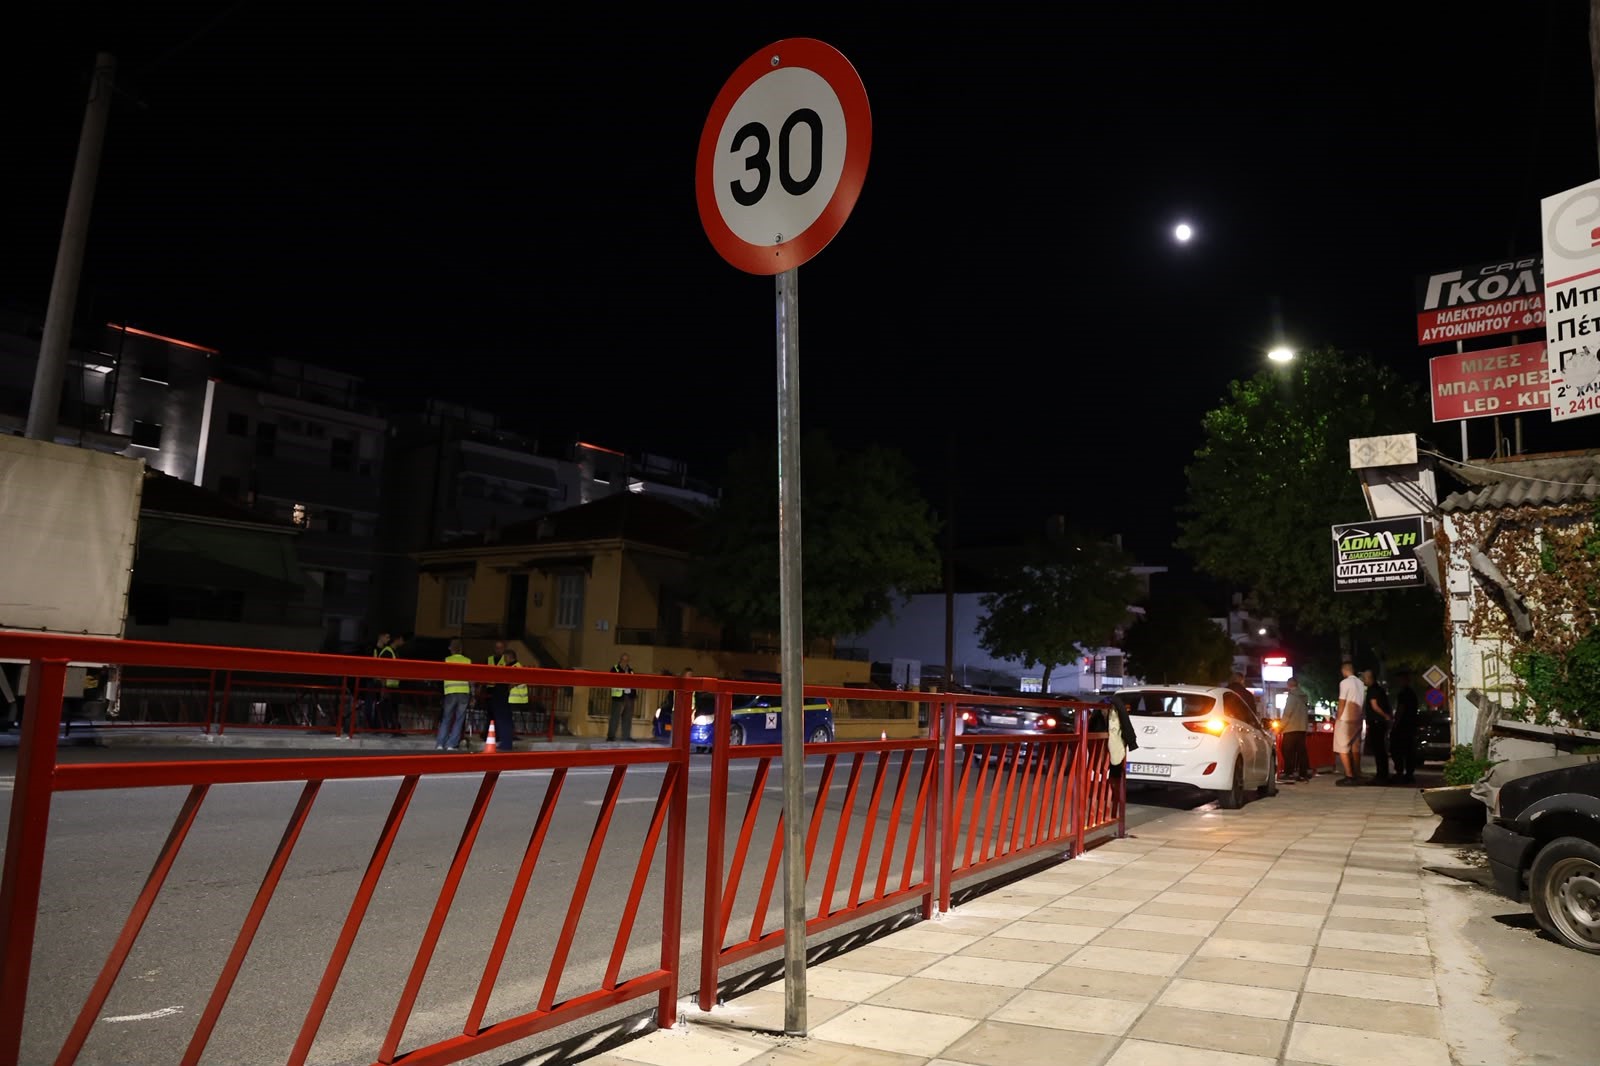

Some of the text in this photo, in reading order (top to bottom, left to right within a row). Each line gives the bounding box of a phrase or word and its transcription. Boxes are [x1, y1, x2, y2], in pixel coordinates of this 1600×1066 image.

[730, 108, 823, 206] 30
[1436, 296, 1542, 325] ΗΛΕΚΤΡΟΛΟΓΙΚΑ
[1422, 315, 1512, 341] ΑΥΤΟΚΙΝΗΤΟΥ
[1461, 353, 1522, 375] ΜΙΖΕΣ
[1437, 369, 1550, 398] ΜΠΑΤΑΡΙΕΣ
[1463, 396, 1500, 413] LED
[1339, 560, 1416, 576] ΜΠΑΤΣΙΛΑΣ
